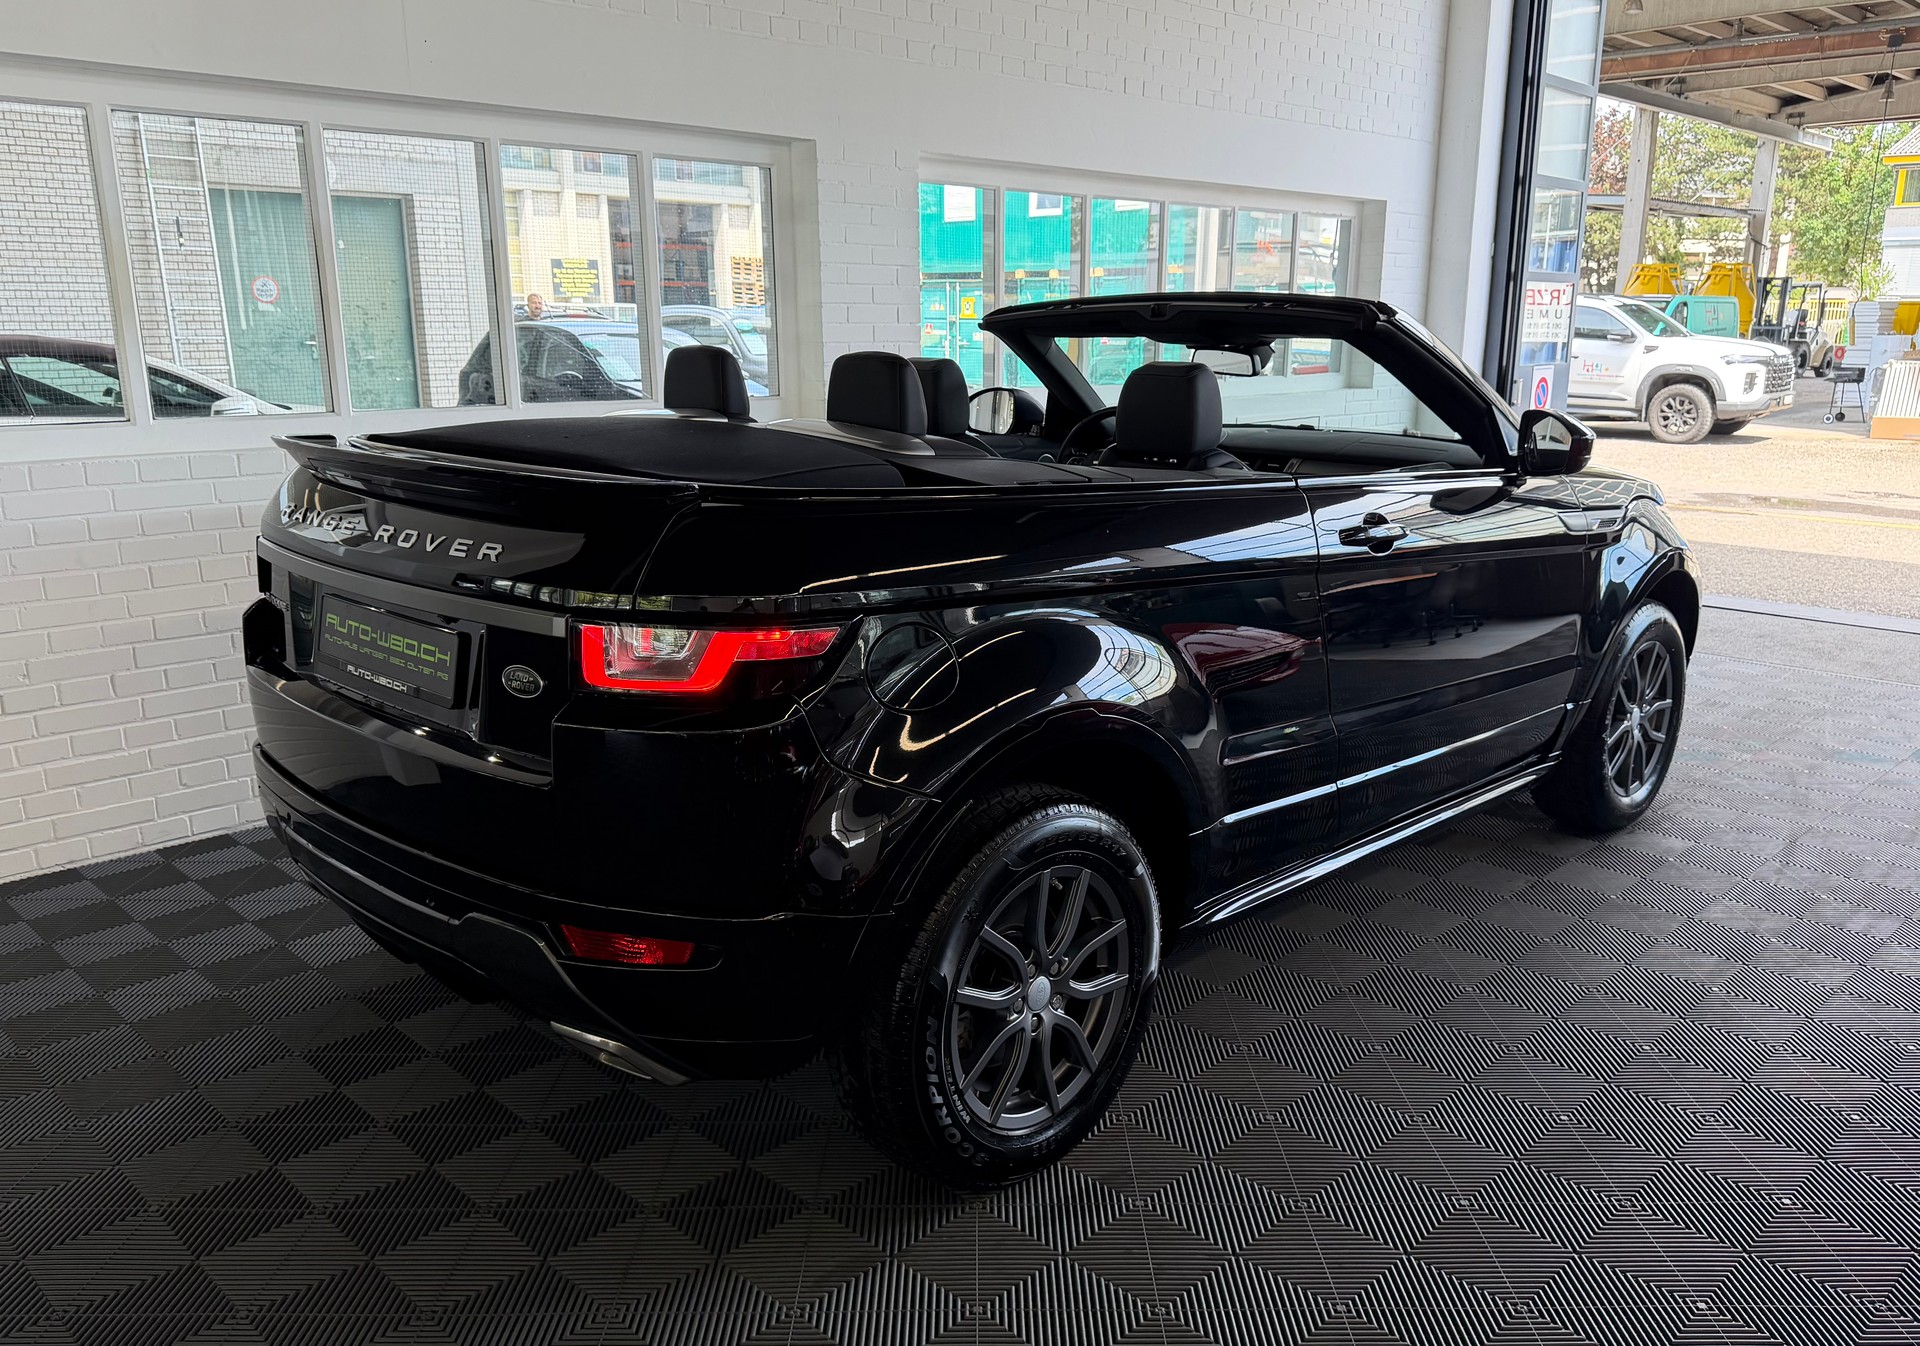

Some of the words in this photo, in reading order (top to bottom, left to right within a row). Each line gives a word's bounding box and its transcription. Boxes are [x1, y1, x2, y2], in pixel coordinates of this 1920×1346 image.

[281, 502, 361, 536] RANGE
[373, 524, 504, 563] ROVER
[406, 662, 435, 676] OLTEN
[436, 671, 449, 681] AG
[925, 1015, 990, 1167] SCORPION
